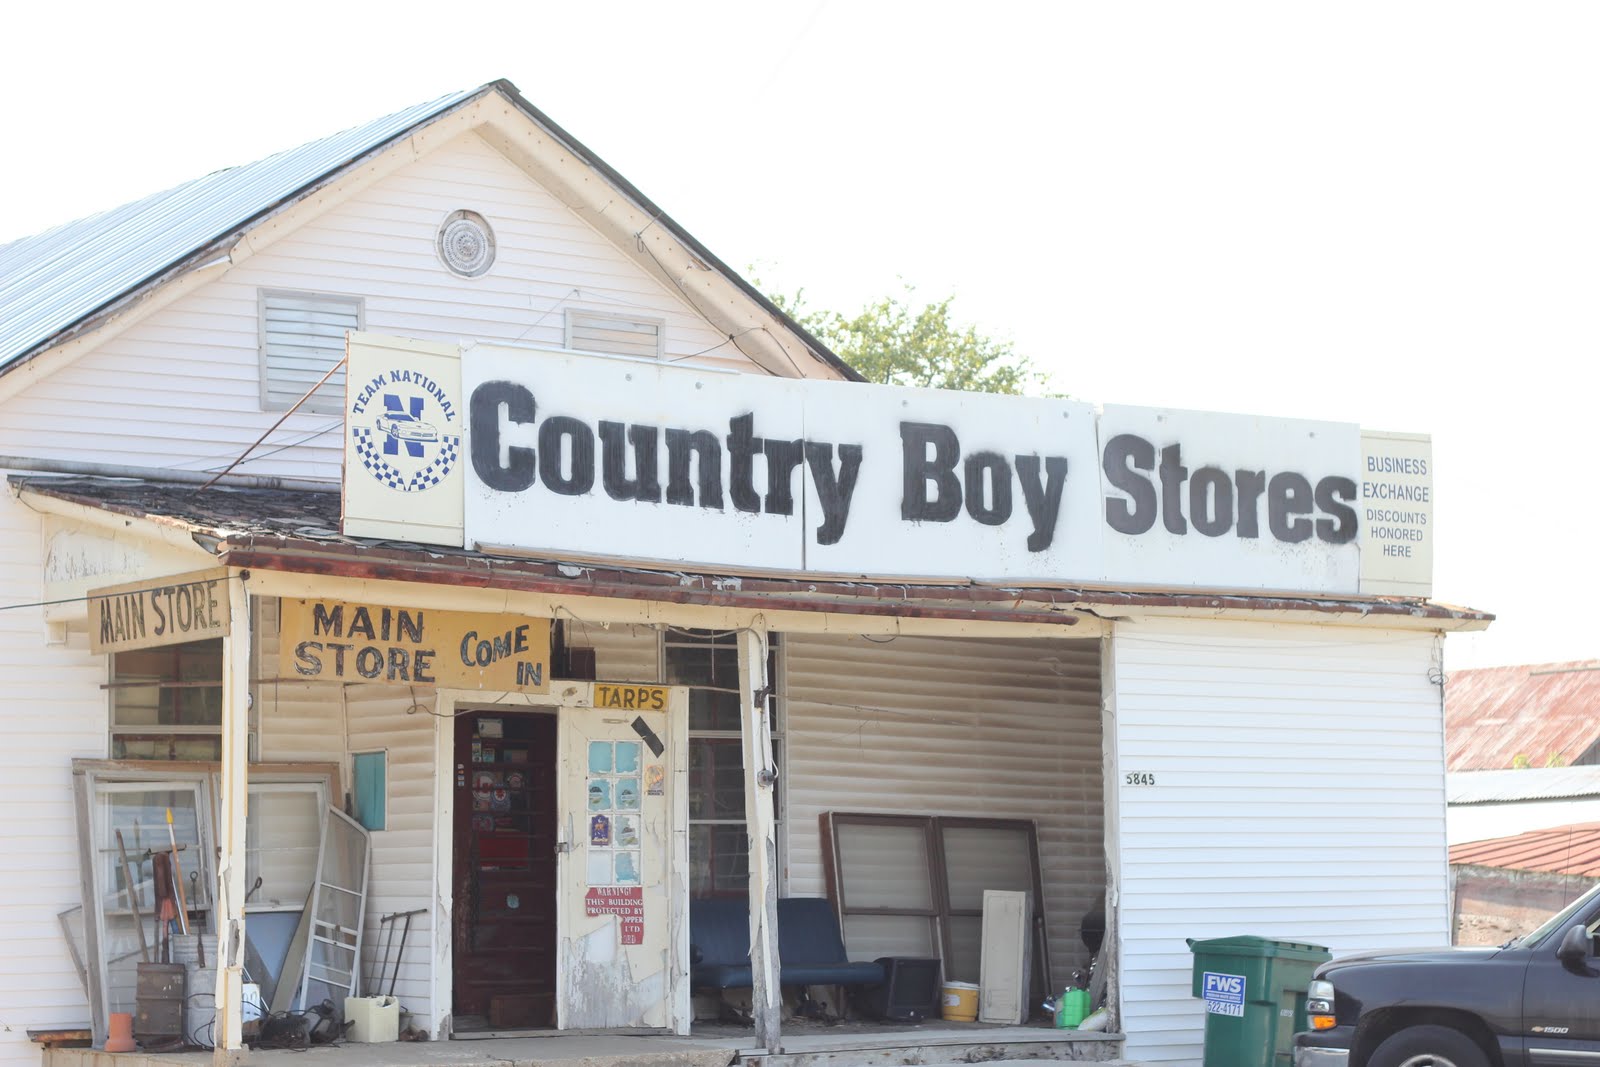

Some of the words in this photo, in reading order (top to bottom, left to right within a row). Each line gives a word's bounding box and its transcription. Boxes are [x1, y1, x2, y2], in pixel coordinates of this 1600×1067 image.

[353, 374, 387, 414] TEAM
[390, 370, 456, 422] NATIONAL
[470, 380, 862, 546] Country
[900, 421, 1068, 552] Boy
[1103, 433, 1358, 544] Stores
[1367, 456, 1427, 475] BUSINESS
[1363, 482, 1429, 502] EXCHANGE
[1366, 508, 1427, 525] DISCOUNTS
[1371, 526, 1423, 541] HONORED
[1383, 544, 1411, 558] HERE
[100, 592, 146, 645] MAIN
[151, 580, 221, 636] STORE
[313, 603, 424, 644] MAIN
[460, 624, 529, 667] COME
[294, 641, 437, 683] STORE
[516, 661, 542, 686] IN
[599, 686, 664, 710] TARPS
[1126, 771, 1155, 785] 5845
[586, 898, 605, 906] THIS
[608, 898, 643, 906] BUILDING
[587, 907, 631, 915] PROTECTED
[633, 907, 643, 915] BY
[1207, 975, 1242, 993] FWS
[1207, 1000, 1241, 1015] 522-4171
[1544, 1026, 1569, 1034] 1500
